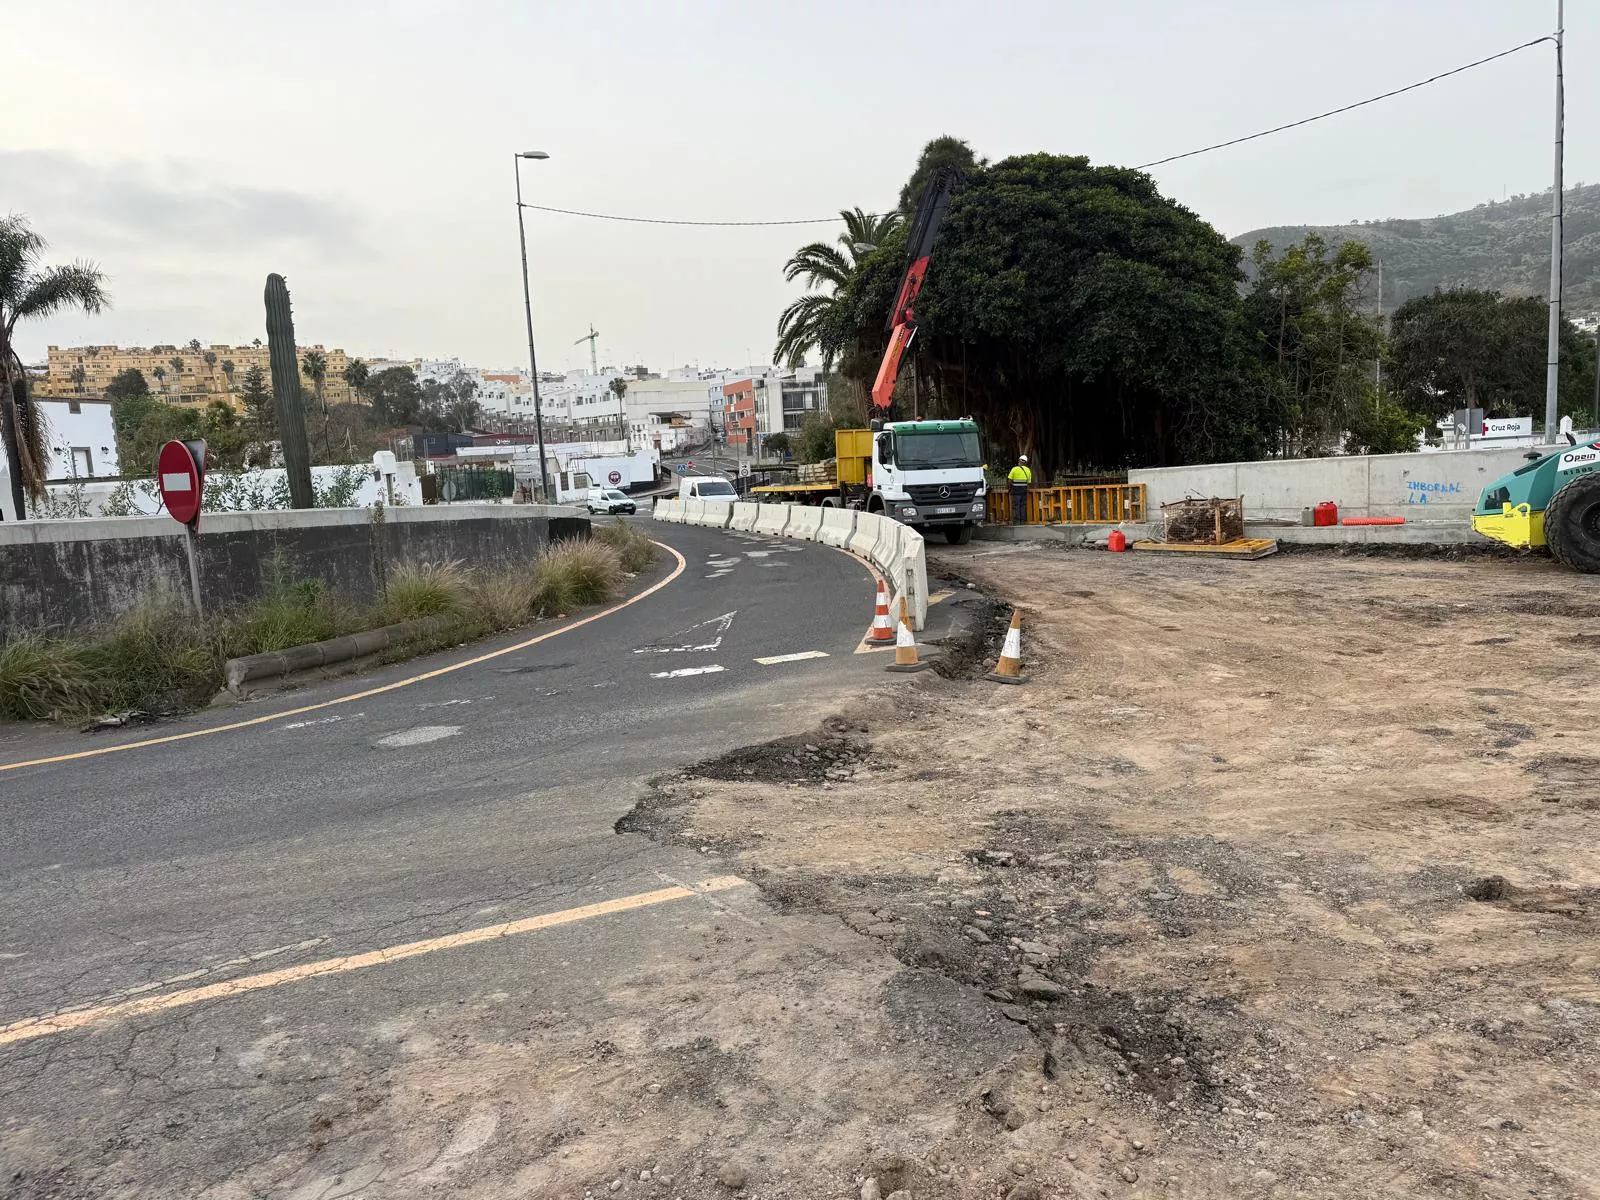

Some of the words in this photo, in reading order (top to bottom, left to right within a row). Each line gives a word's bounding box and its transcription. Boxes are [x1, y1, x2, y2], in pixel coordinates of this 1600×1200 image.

[1491, 424, 1506, 432] Cruz
[1506, 423, 1521, 431] Roja
[1564, 453, 1596, 462] Opein
